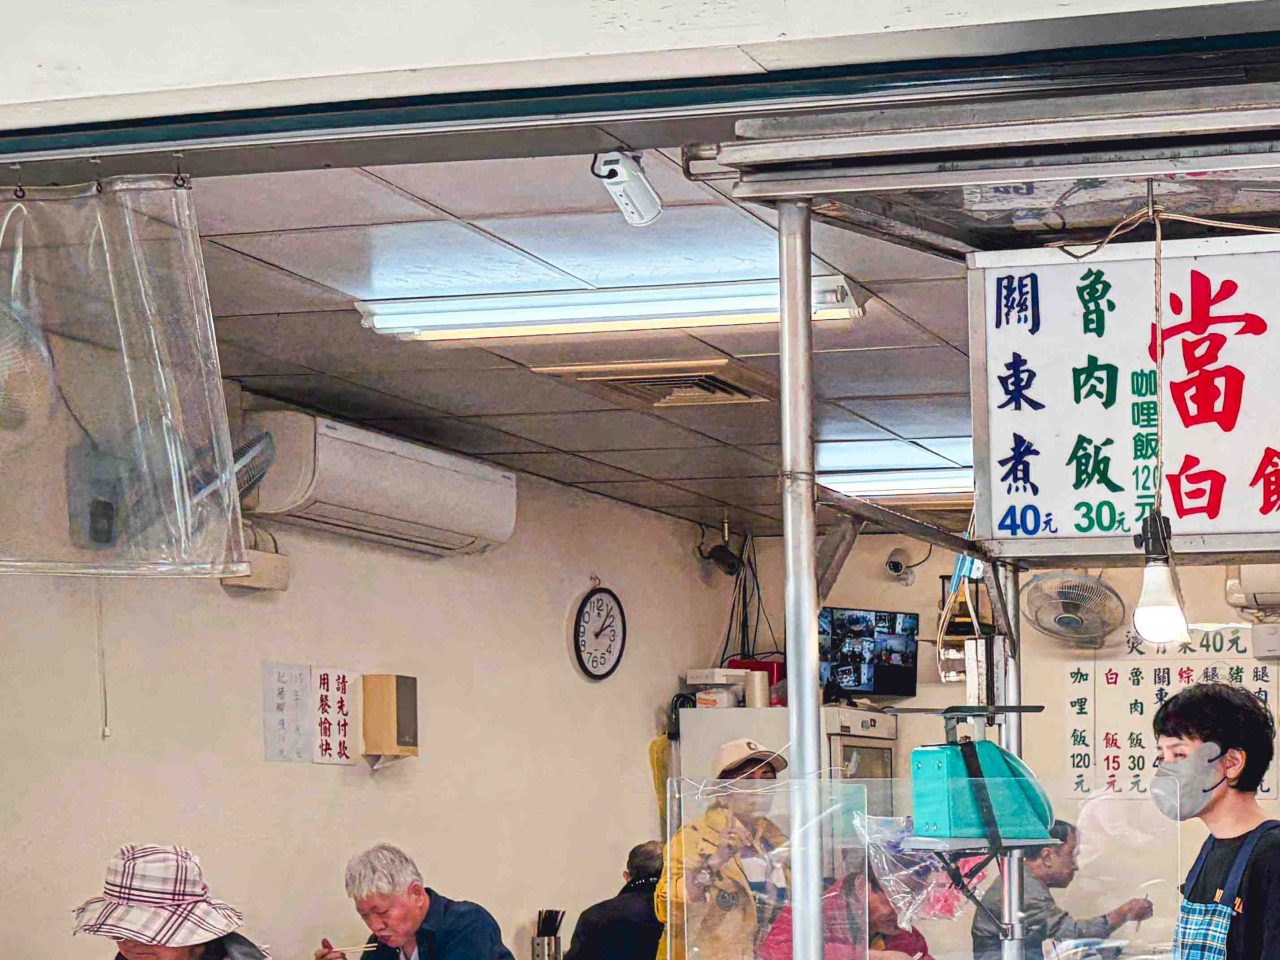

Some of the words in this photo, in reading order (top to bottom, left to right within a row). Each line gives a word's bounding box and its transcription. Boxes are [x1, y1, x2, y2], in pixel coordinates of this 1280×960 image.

[995, 273, 1045, 497] 關東煮
[318, 673, 332, 758] 用餐愉快
[336, 674, 350, 760] 請先付款
